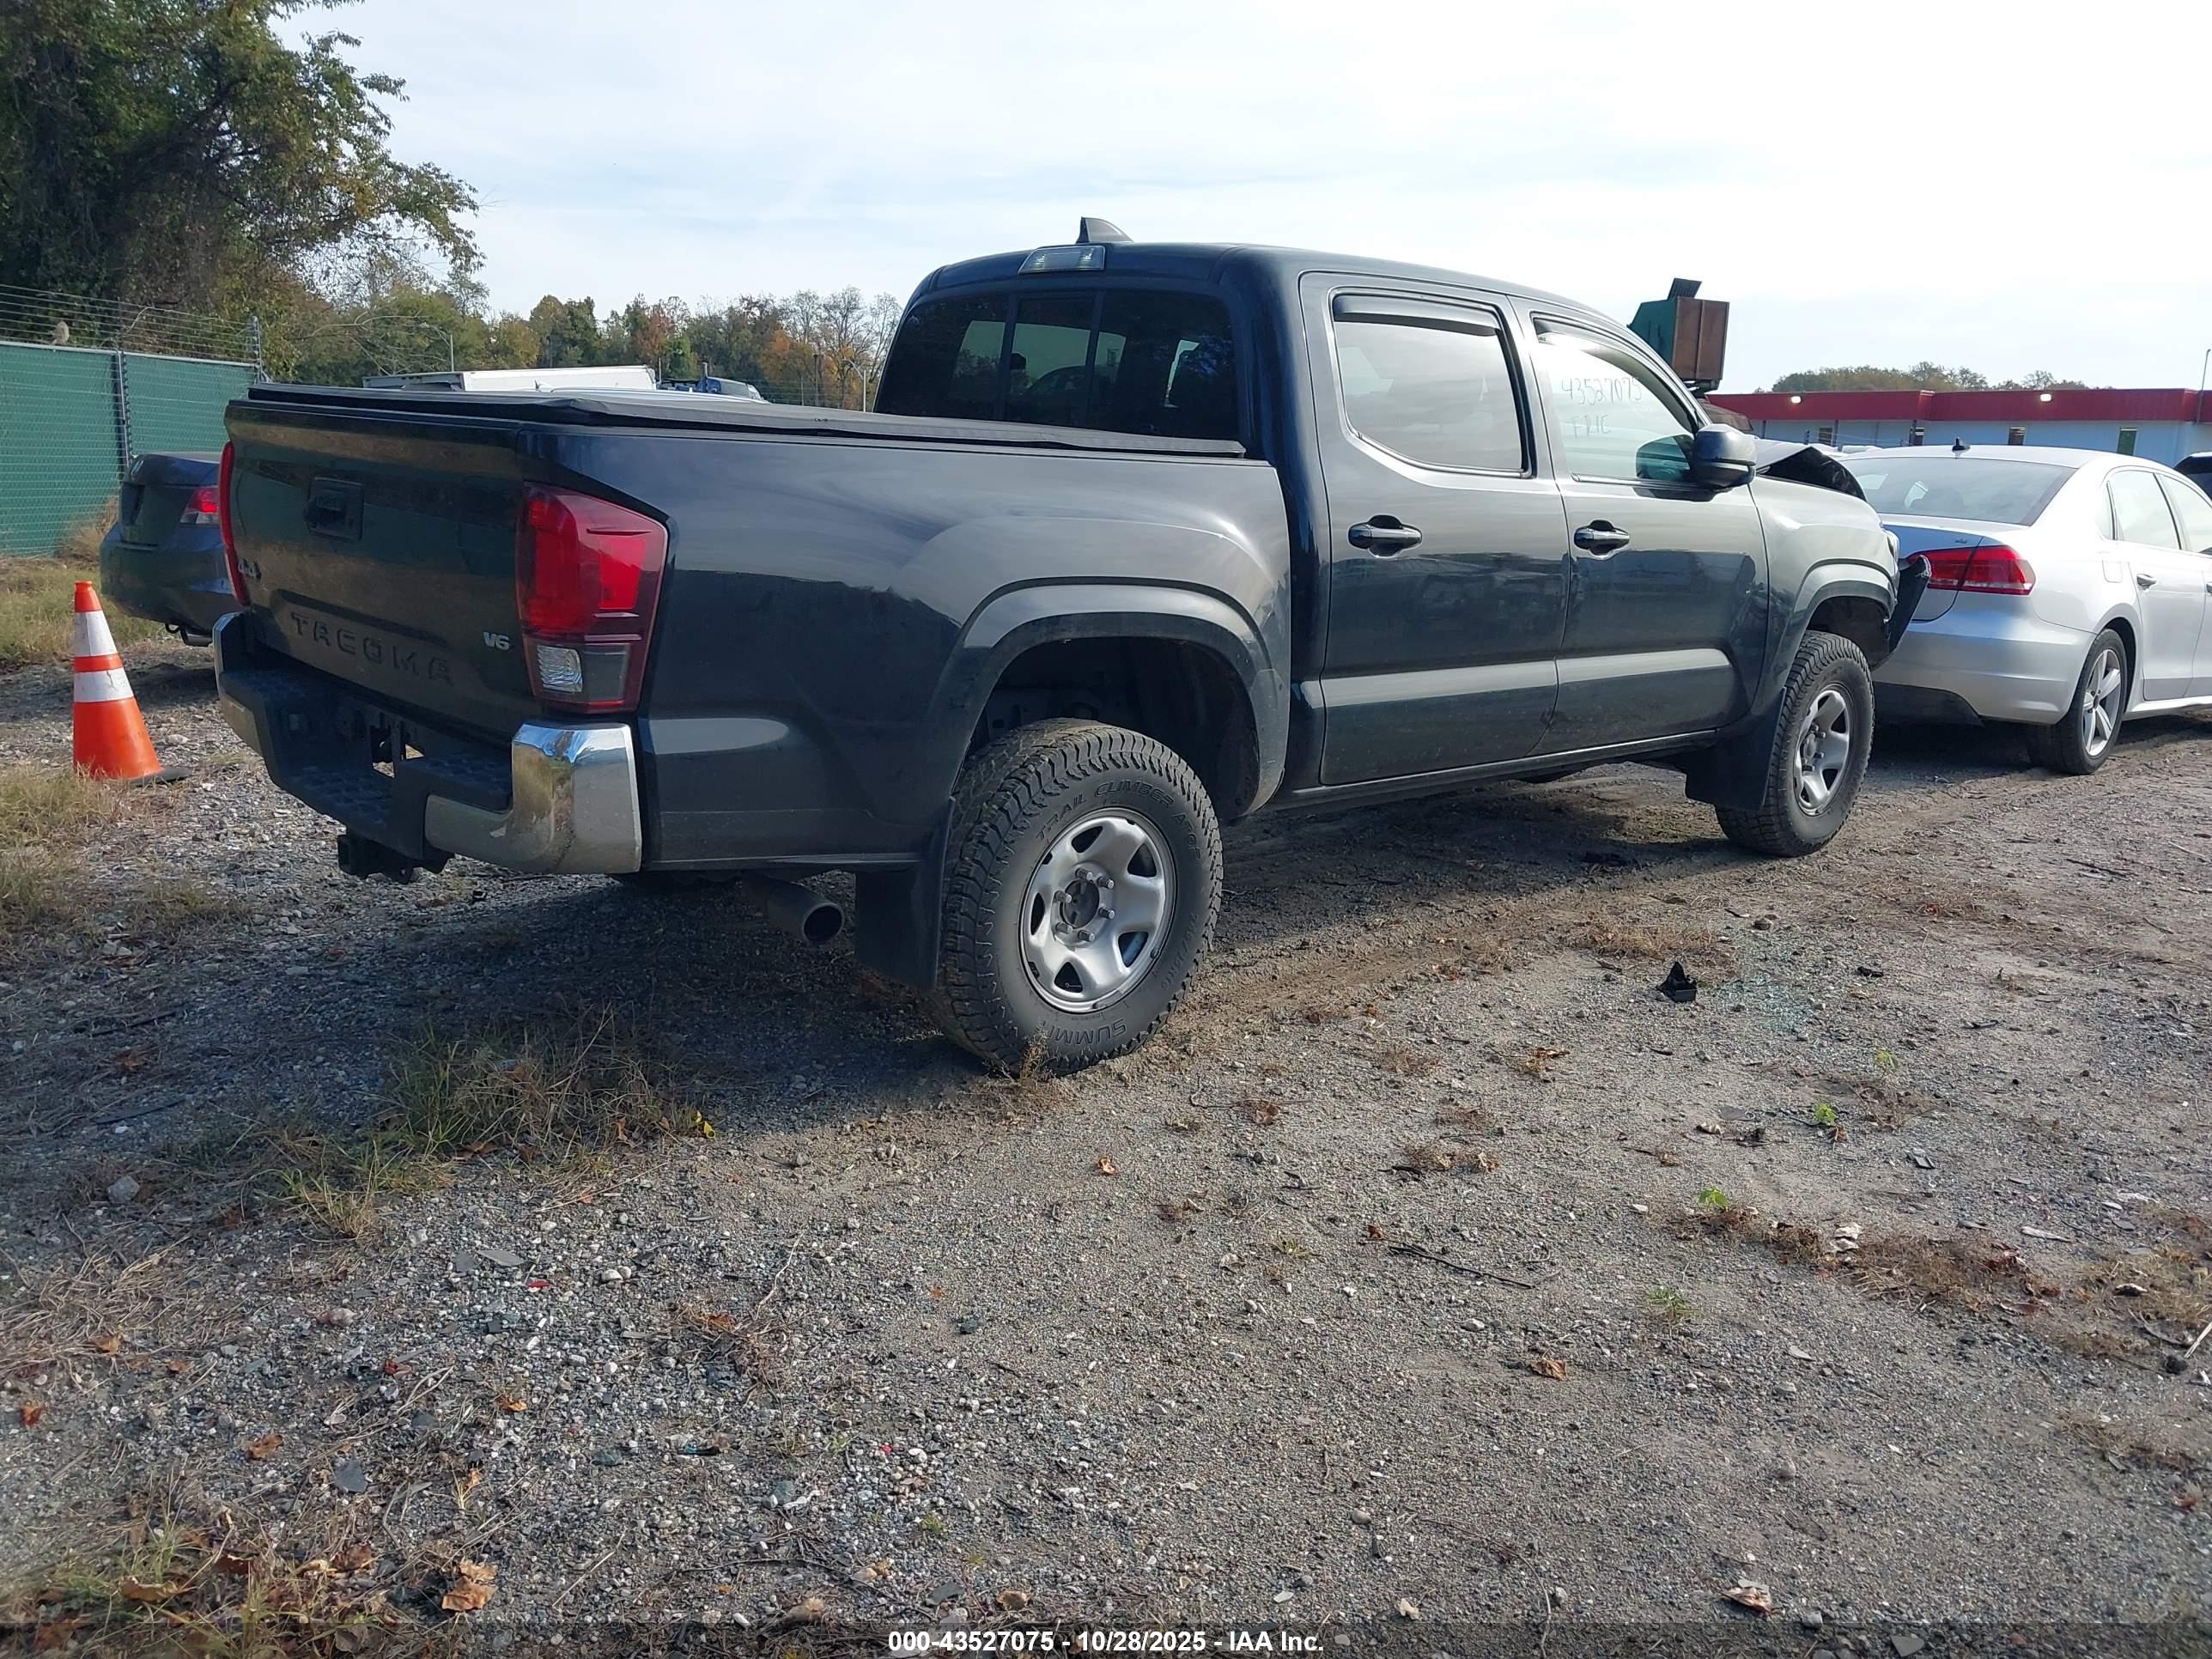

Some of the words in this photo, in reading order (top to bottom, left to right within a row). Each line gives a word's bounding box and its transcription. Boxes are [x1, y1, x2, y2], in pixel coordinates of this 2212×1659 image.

[290, 611, 453, 684] TACOMA
[483, 631, 511, 651] V6
[1094, 780, 1175, 808] CLIMBER
